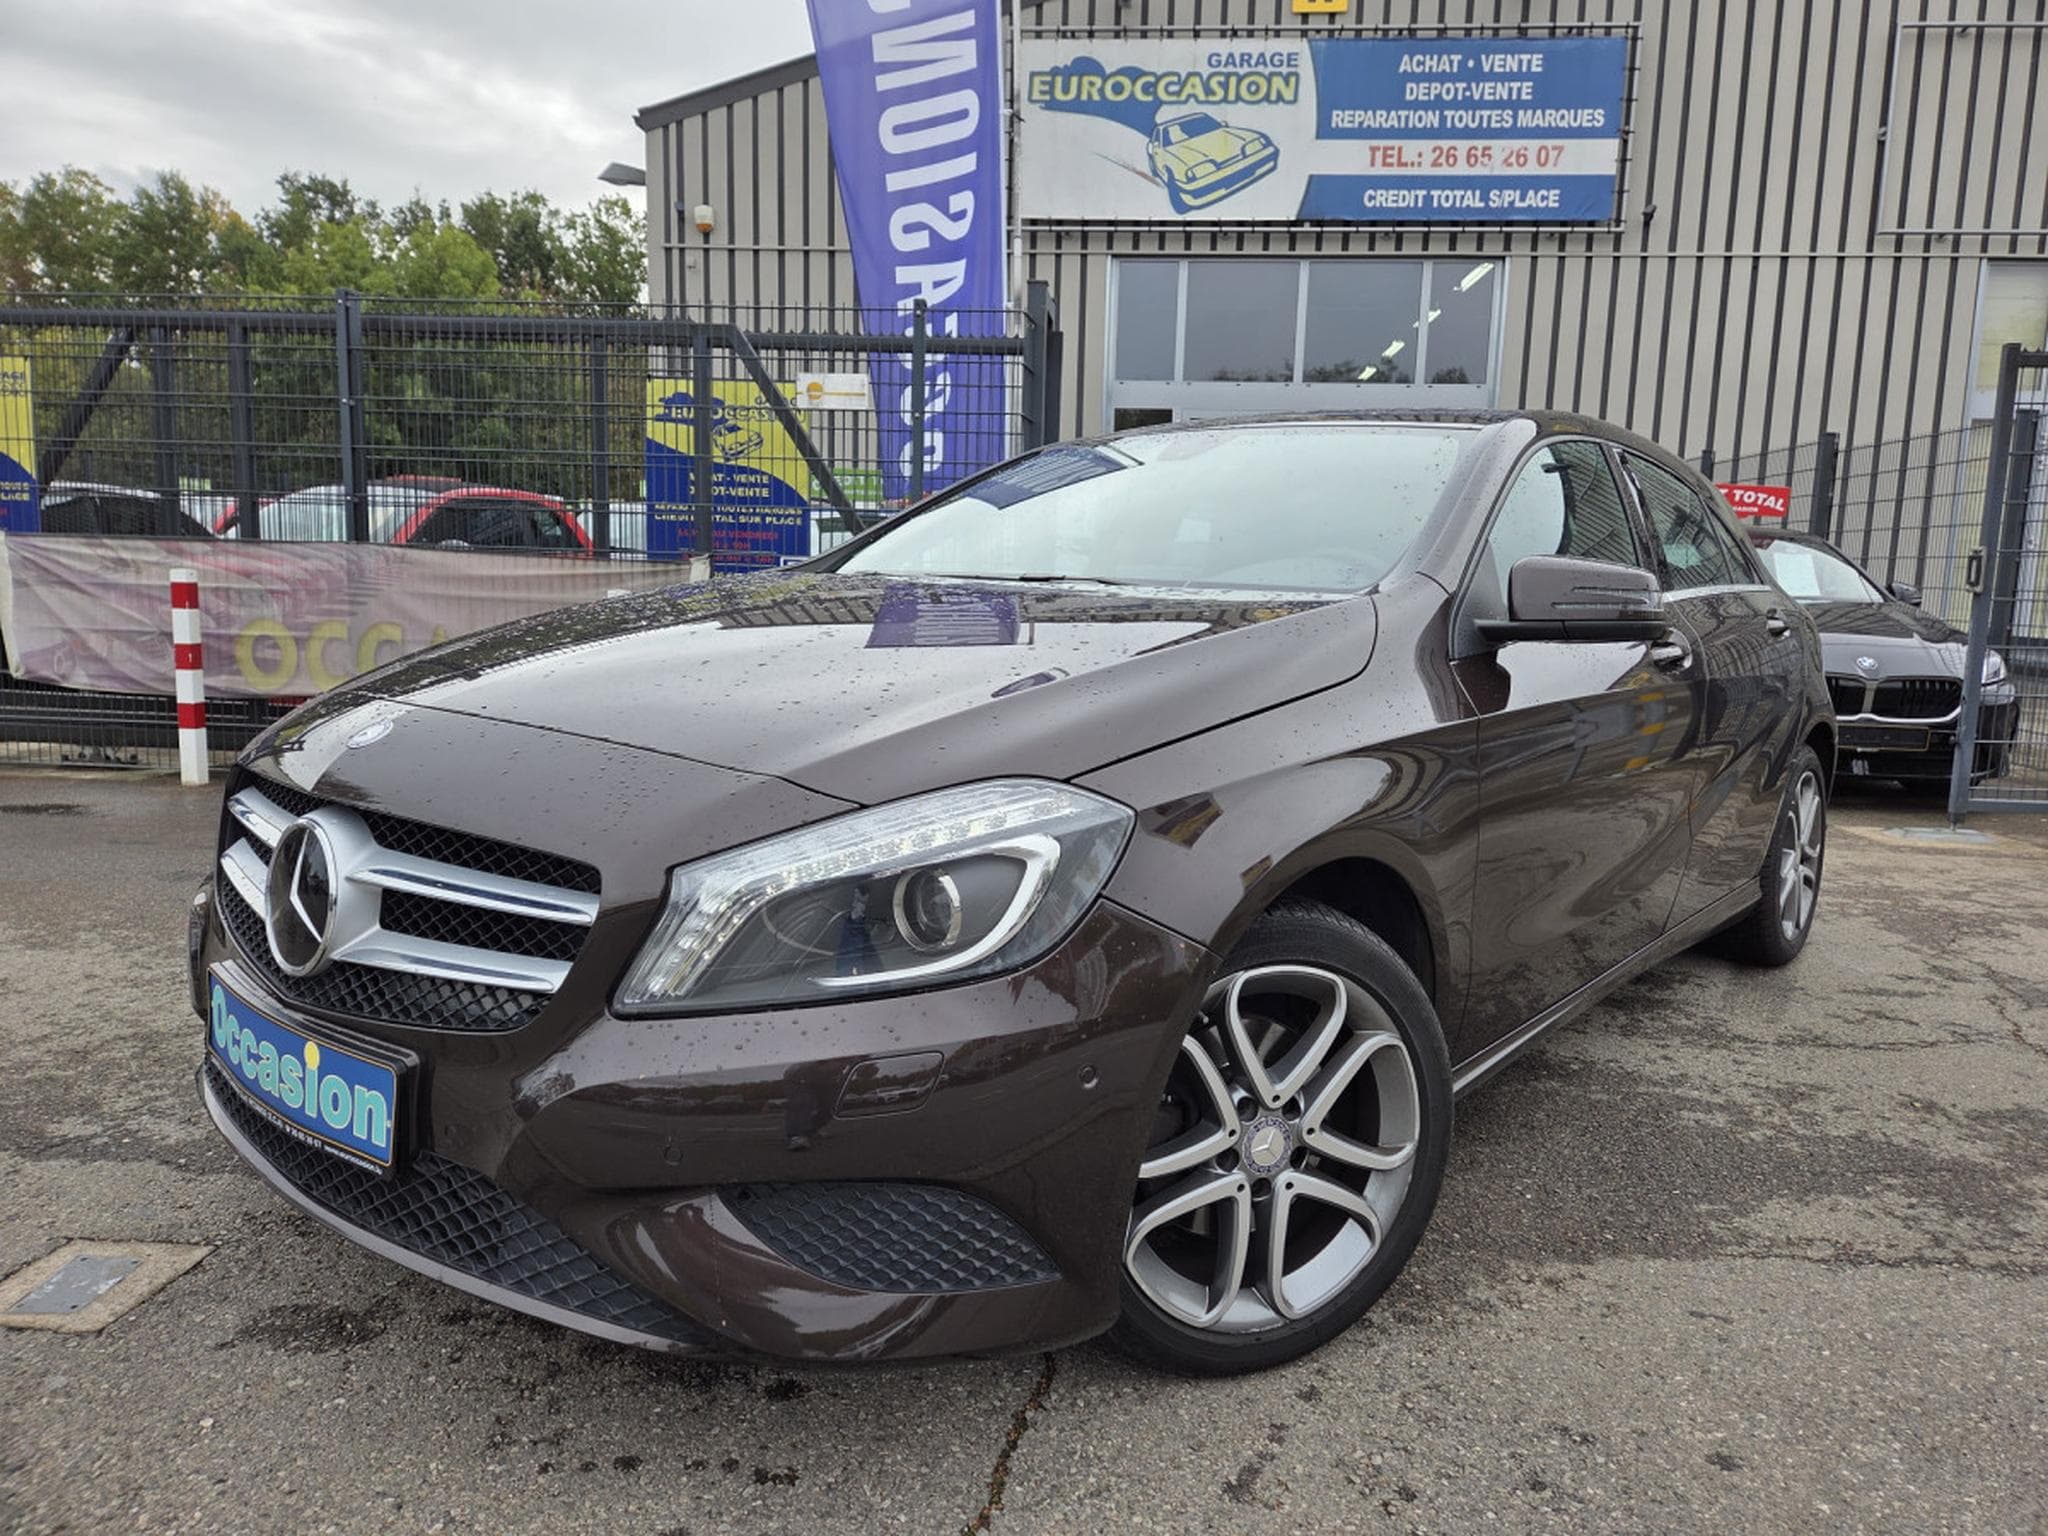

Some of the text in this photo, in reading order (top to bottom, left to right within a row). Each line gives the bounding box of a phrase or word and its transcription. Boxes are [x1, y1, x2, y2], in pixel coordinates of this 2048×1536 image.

[1207, 52, 1299, 69] GARAGE
[1398, 54, 1543, 73] ACHAT VENTE
[1030, 72, 1299, 104] EUROCCASION
[1405, 82, 1533, 100] DEPOT-VENTE
[1331, 108, 1605, 129] REPARATION TOUTES MARQUES
[1369, 145, 1564, 168] TEL.: 26 65 26 07
[1363, 189, 1560, 208] CREDIT TOTAL S/PLACE
[734, 473, 769, 484] VENTE
[1733, 488, 1785, 512] TOTAL
[738, 515, 762, 524] SUR
[765, 516, 803, 526] PLACE
[211, 984, 388, 1148] Occasion
